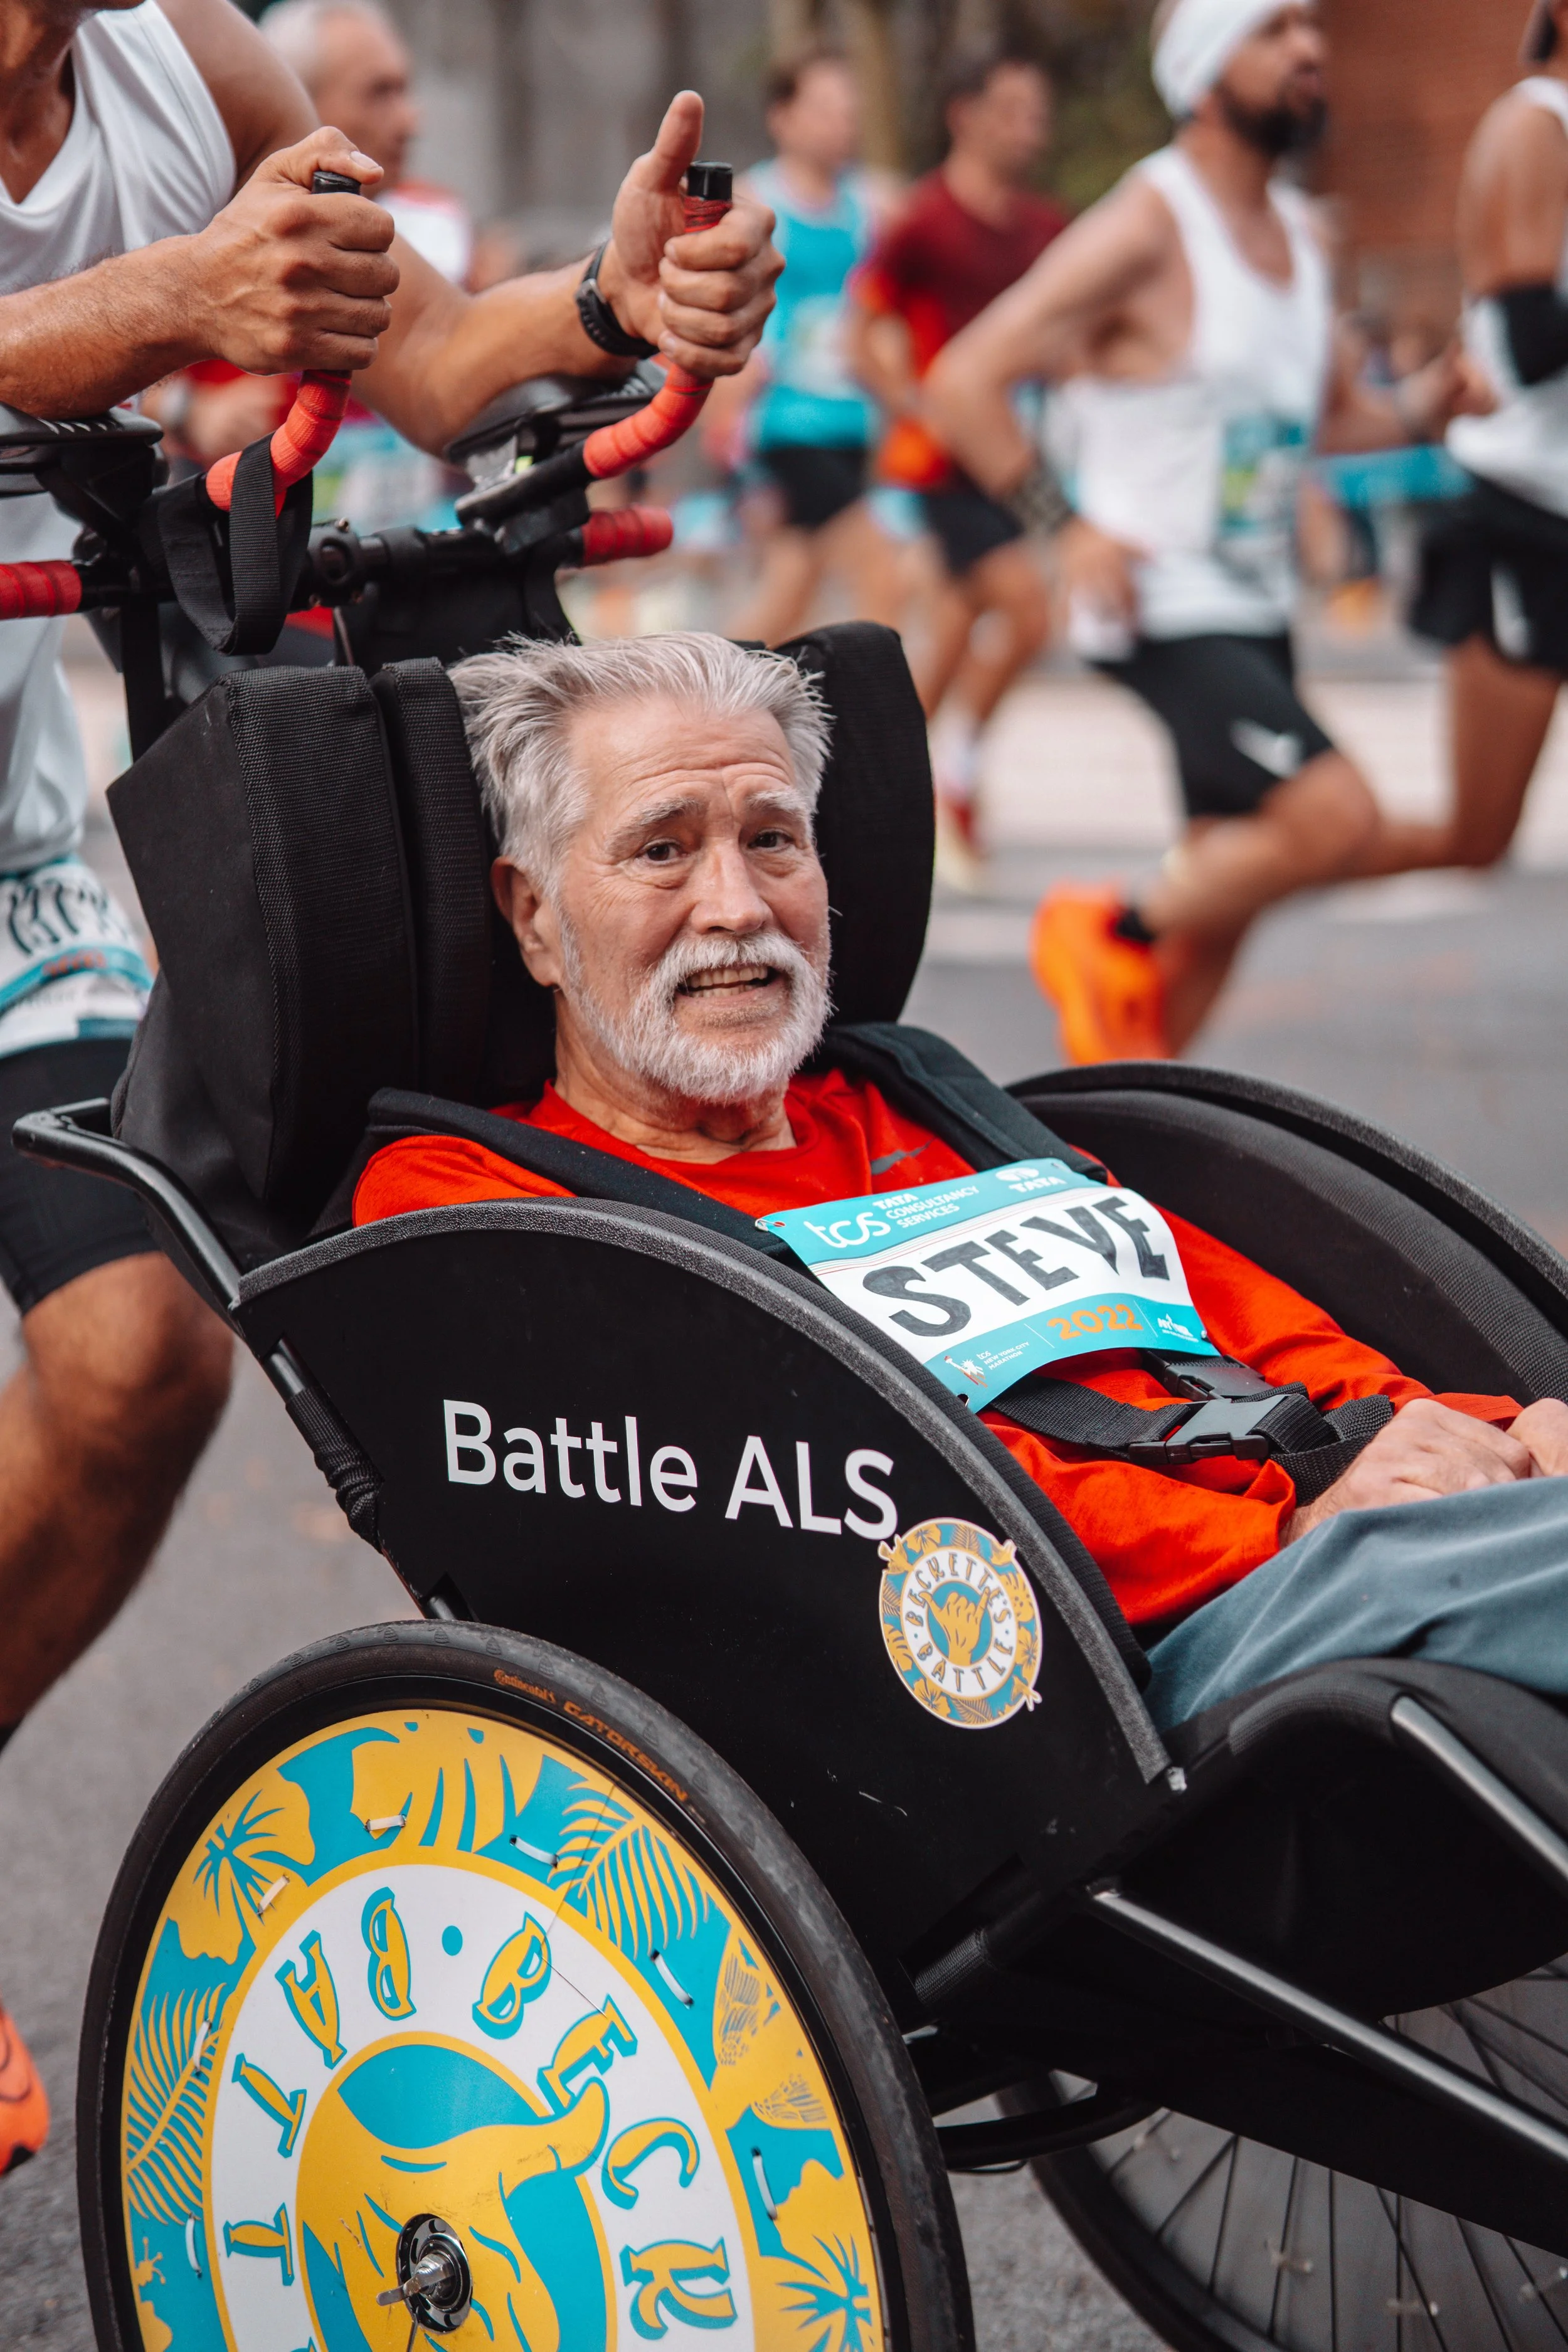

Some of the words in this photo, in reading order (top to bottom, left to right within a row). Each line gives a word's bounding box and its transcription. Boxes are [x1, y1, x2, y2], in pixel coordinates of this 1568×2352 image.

[872, 1193, 919, 1210] TATA
[886, 1185, 980, 1219] CONSULTANCY
[1009, 1176, 1067, 1192] TATA
[803, 1211, 891, 1248] tcs
[896, 1203, 960, 1228] SERVICES
[862, 1196, 1170, 1337] STEVE
[1047, 1304, 1144, 1340] 2022
[983, 1354, 999, 1365] NEW
[999, 1347, 1016, 1357] YORK
[1015, 1342, 1030, 1351] CITY
[988, 1351, 1023, 1370] MARATHON
[443, 1399, 698, 1512] Battle
[724, 1435, 898, 1540] ALS
[905, 1552, 1012, 1627] BECKETTE'S
[916, 1637, 1013, 1692] BATTLE
[563, 1700, 689, 1802] GATORSKIN
